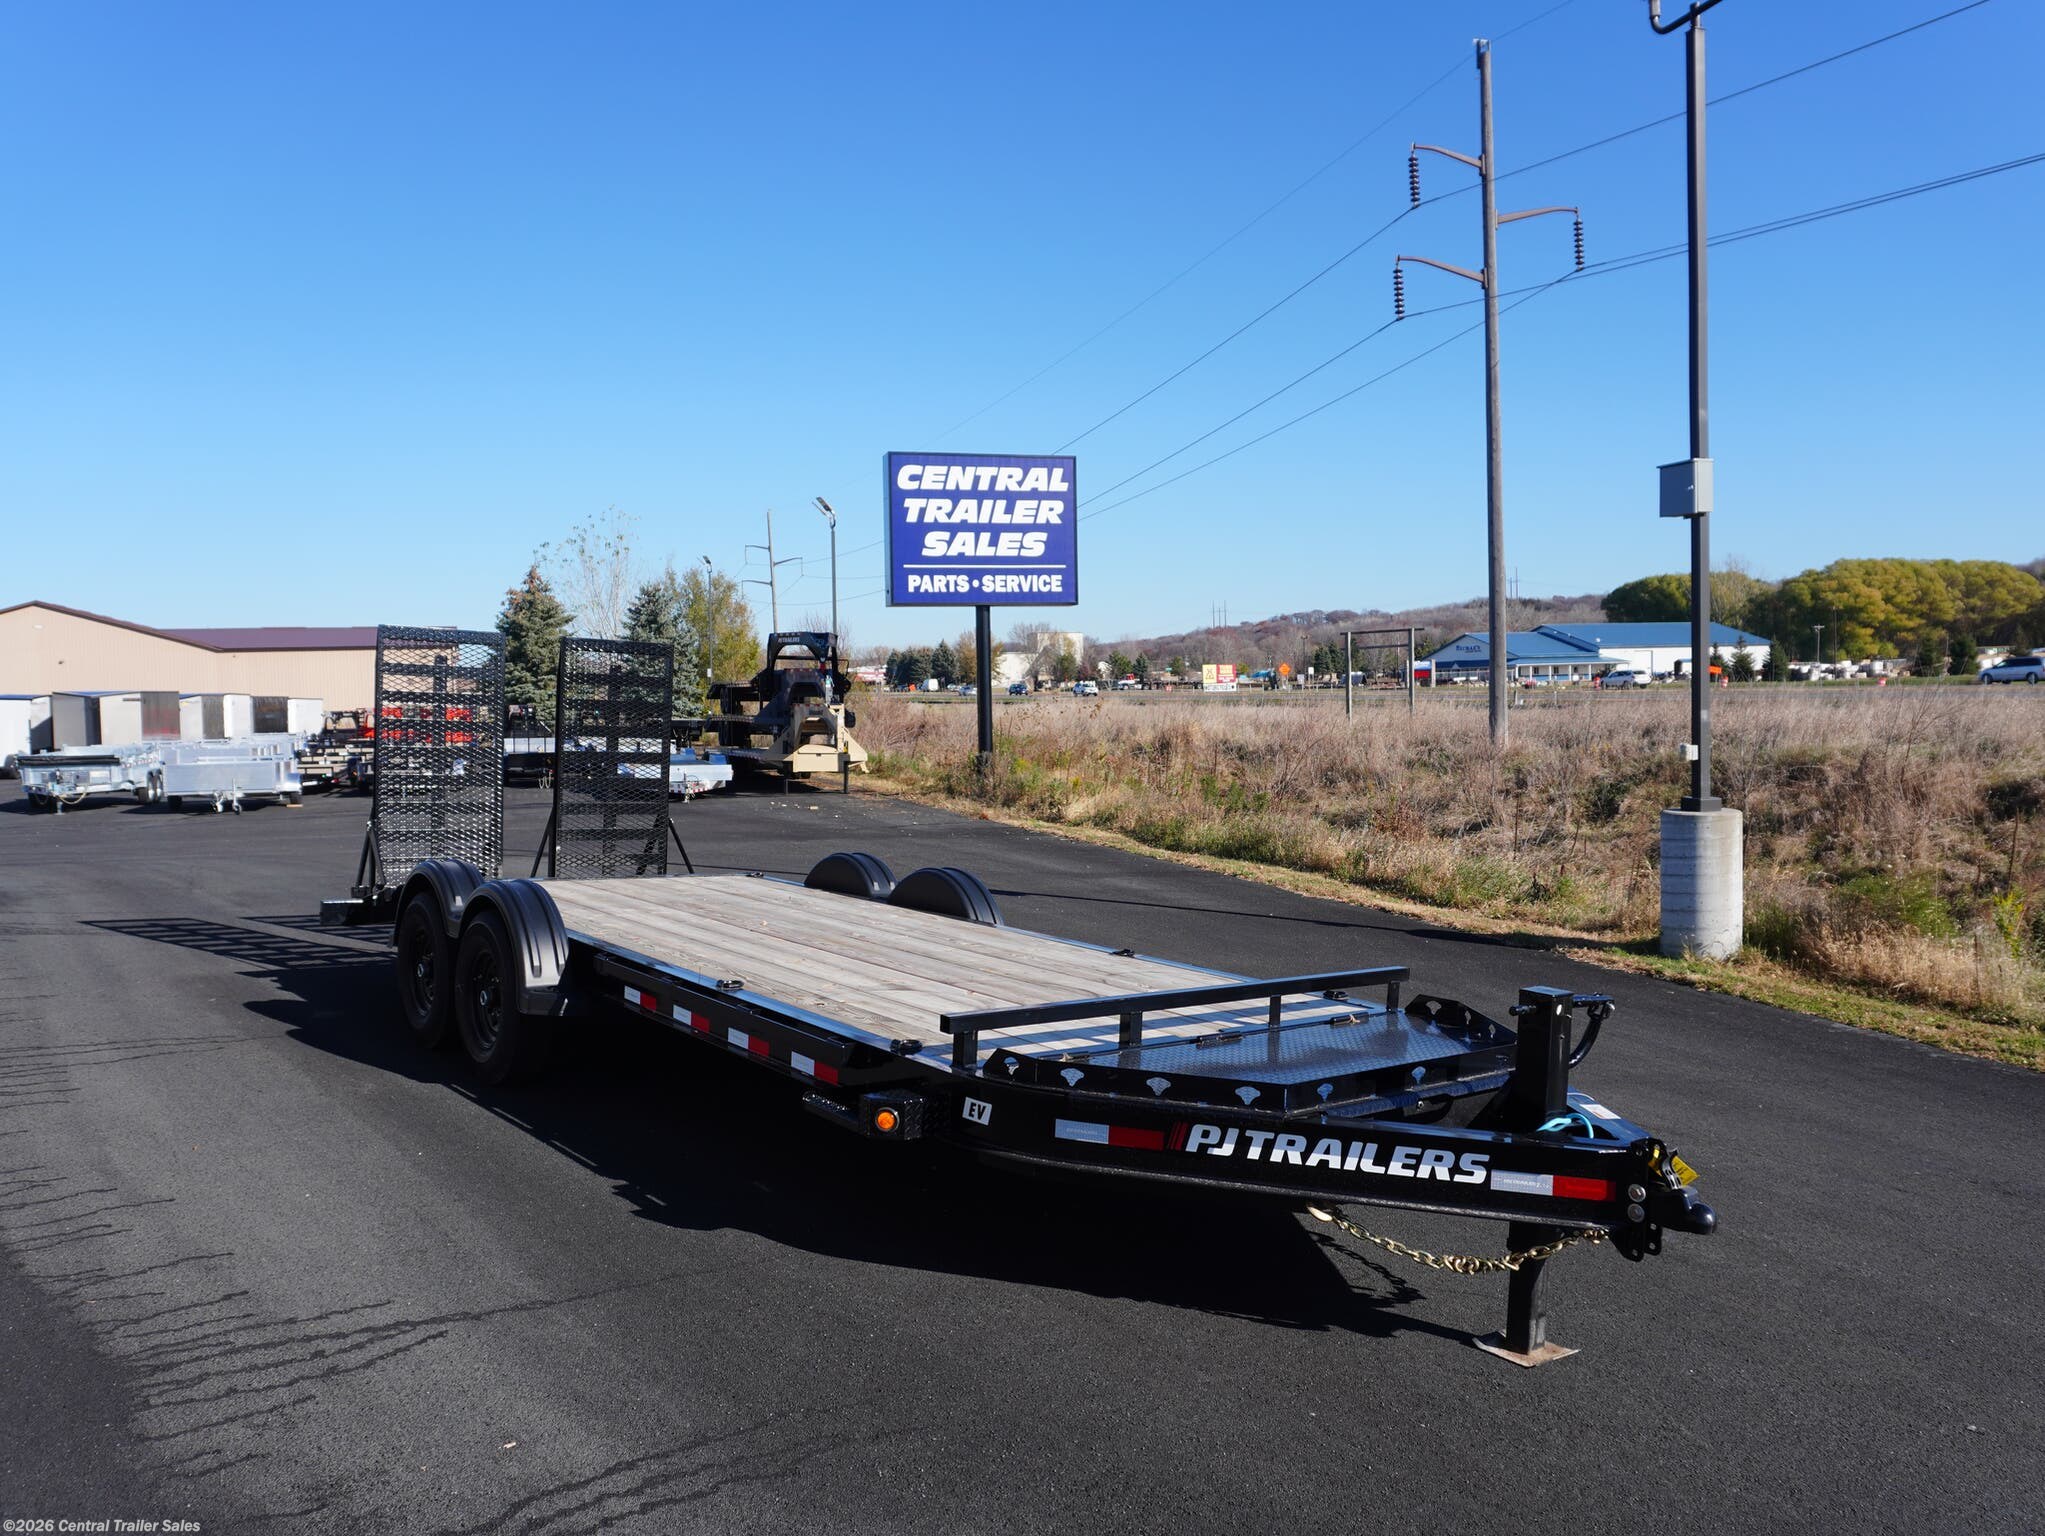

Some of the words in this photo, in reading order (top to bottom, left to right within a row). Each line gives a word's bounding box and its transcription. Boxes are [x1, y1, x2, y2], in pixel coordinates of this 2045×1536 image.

[897, 464, 1069, 492] CENTRAL
[904, 498, 1065, 524] TRAILER
[921, 531, 1048, 557] SALES
[968, 1102, 987, 1120] EV
[1185, 1124, 1240, 1157] PJ
[1245, 1130, 1489, 1184] TRAILERS
